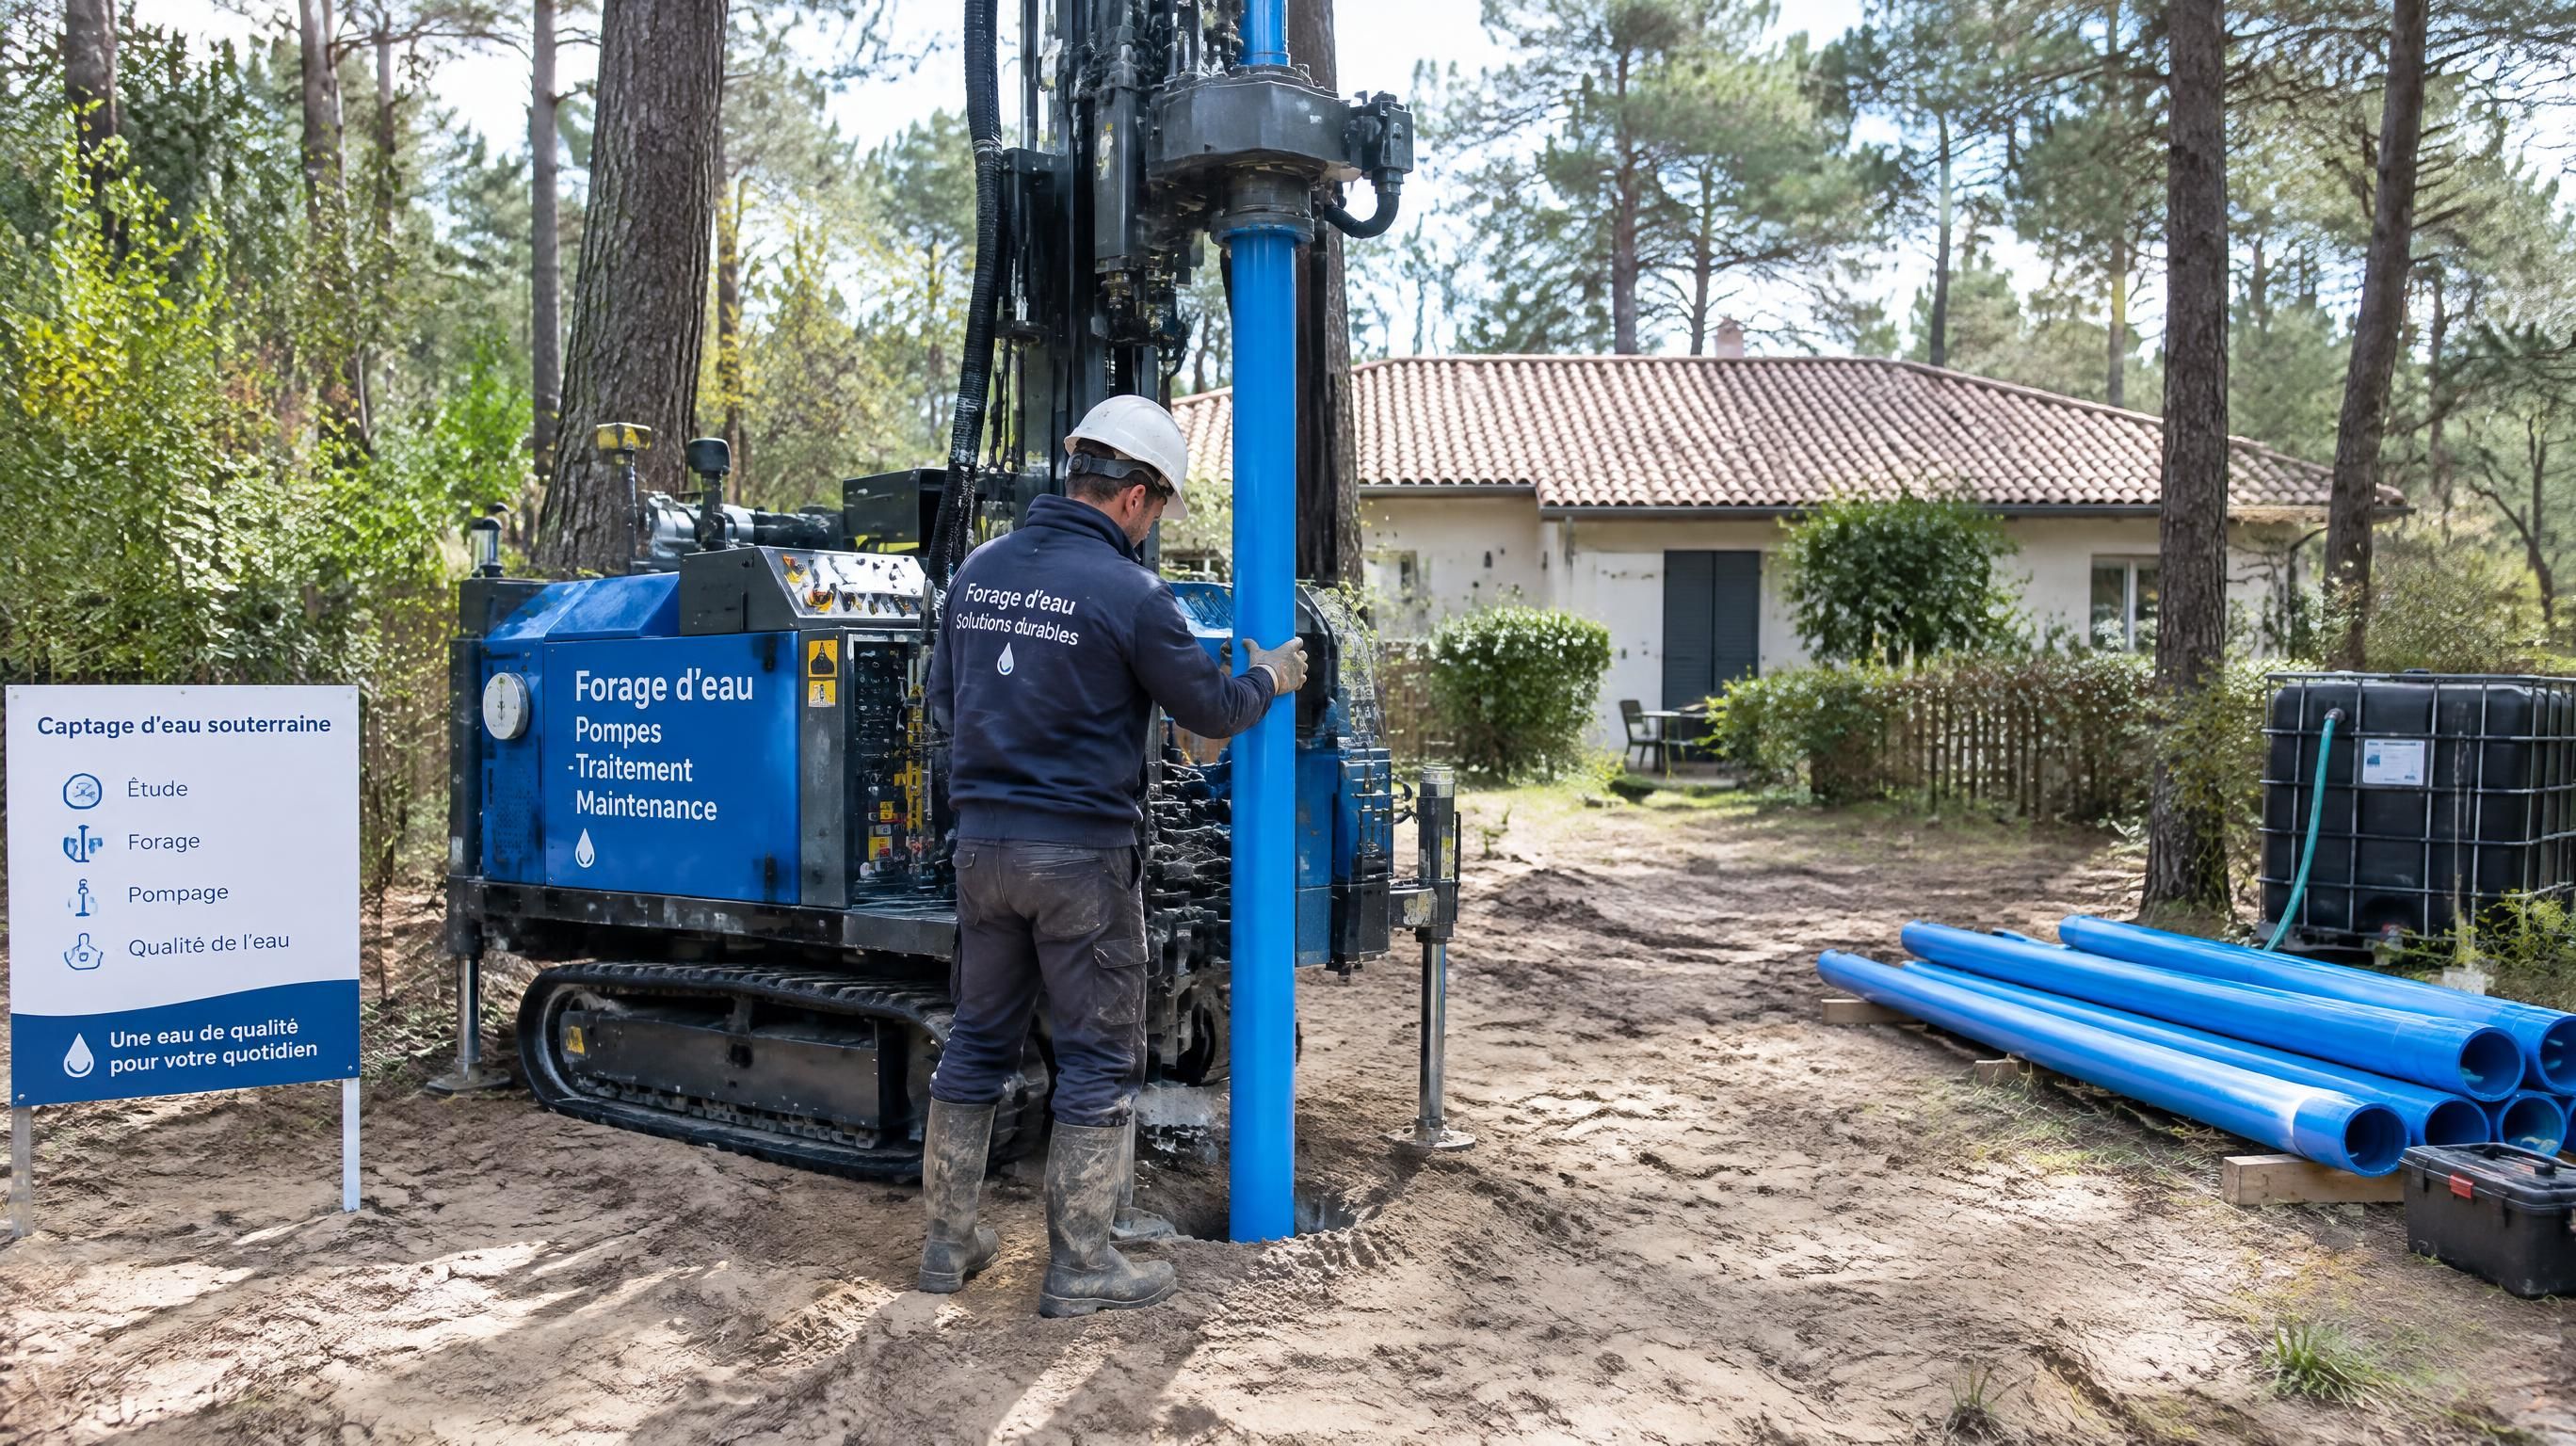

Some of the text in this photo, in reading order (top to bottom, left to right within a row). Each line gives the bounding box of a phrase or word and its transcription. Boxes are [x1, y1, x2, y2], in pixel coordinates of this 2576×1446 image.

[964, 583, 1076, 616] Forage d'eau
[956, 610, 1079, 646] Solutions durables
[575, 667, 753, 710] Forage d'eau
[37, 715, 331, 739] Captage d'eau souterraine
[575, 715, 662, 749] Pompes
[576, 790, 717, 821] Maintenance
[128, 833, 201, 853] Forage
[129, 886, 229, 906] Pompage
[128, 933, 289, 958] Qualité de l'eau
[110, 1018, 298, 1049] Une eau de qualité
[110, 1041, 317, 1077] pour votre quotidien
